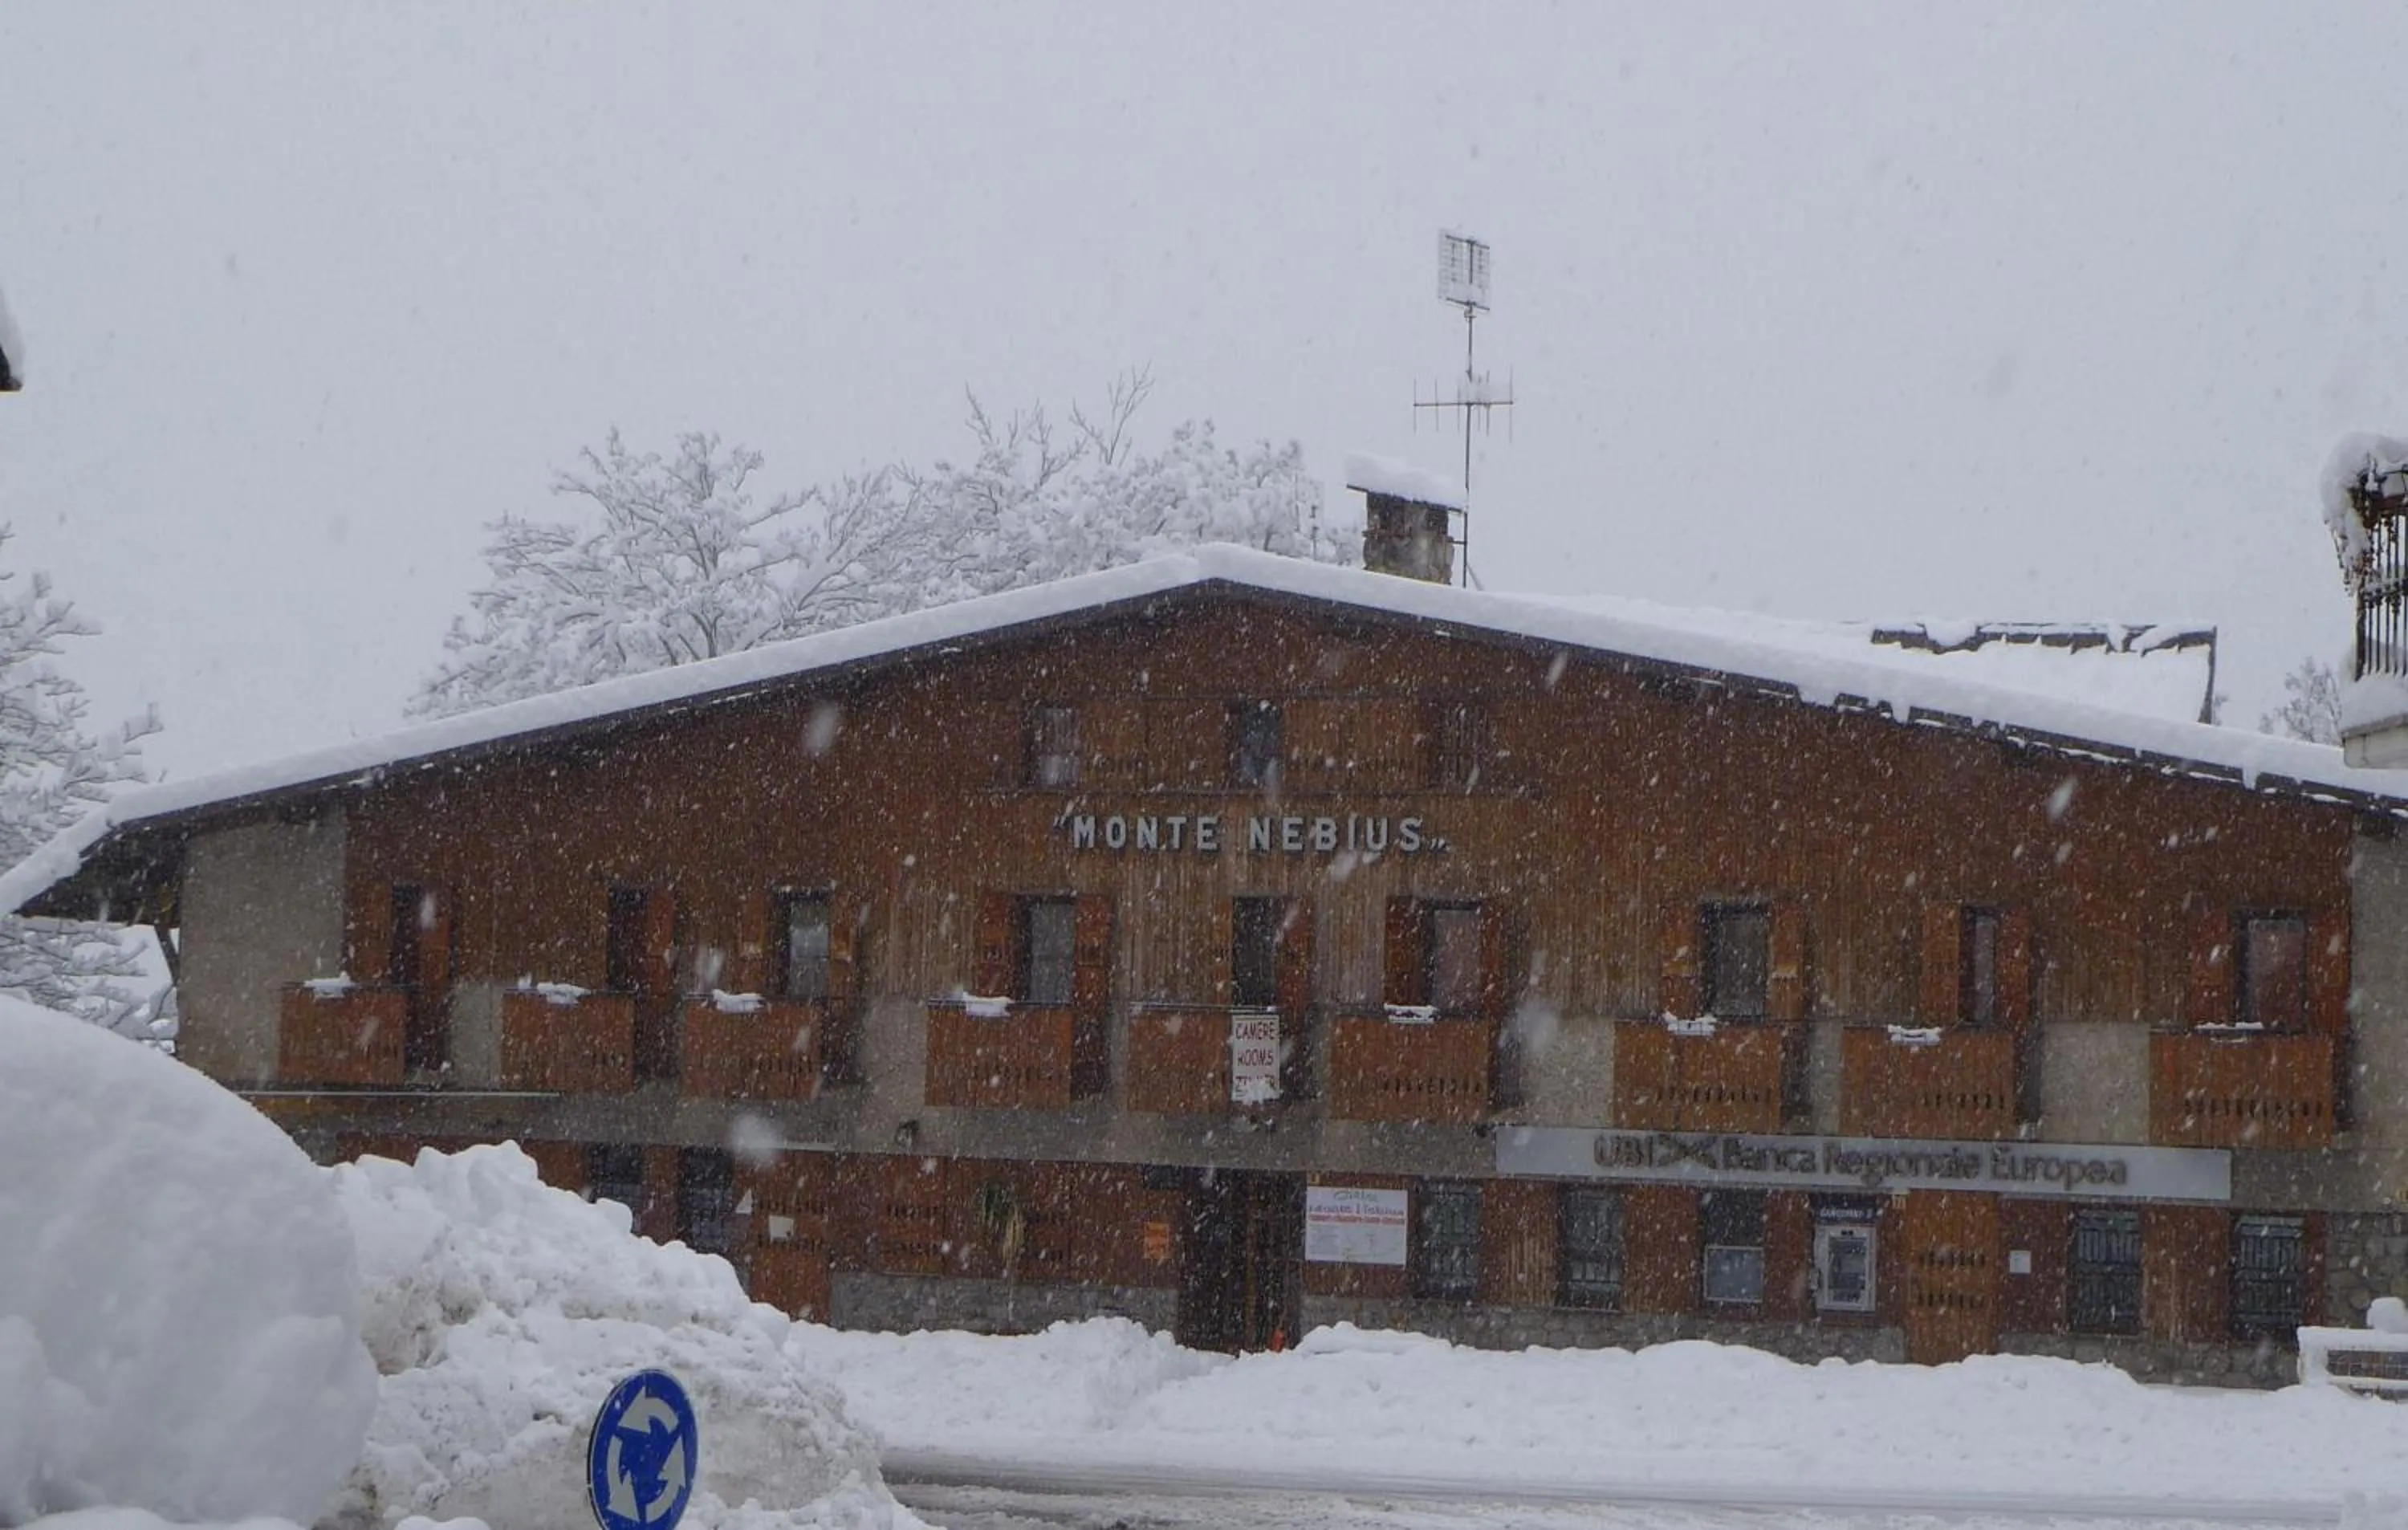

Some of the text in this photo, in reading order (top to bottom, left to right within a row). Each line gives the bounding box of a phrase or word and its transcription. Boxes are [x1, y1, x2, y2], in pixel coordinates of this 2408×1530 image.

[1235, 1020, 1275, 1041] CAMERE
[1237, 1048, 1275, 1067] ROOMS
[1594, 1134, 2128, 1190] UBI Banca Regionale Europea
